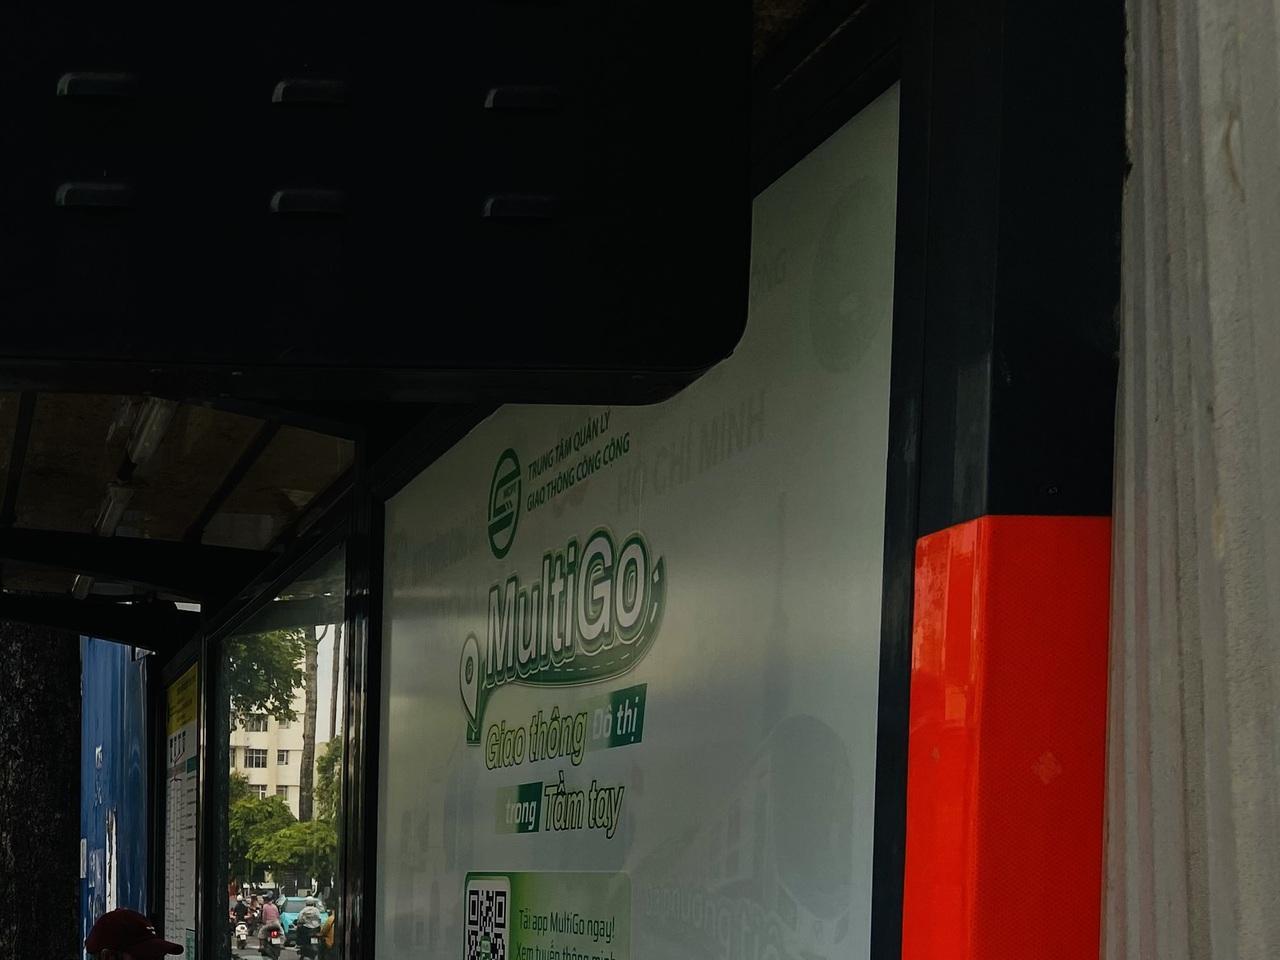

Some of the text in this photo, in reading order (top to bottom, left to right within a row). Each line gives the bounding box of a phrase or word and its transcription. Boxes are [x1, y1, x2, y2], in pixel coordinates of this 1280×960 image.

[526, 486, 545, 513] GIAO
[546, 467, 575, 501] THÔNG
[575, 450, 602, 482] CÔNG
[602, 432, 631, 470] CỘNG
[527, 448, 554, 480] TRUNG
[555, 437, 572, 464] TÂM
[573, 416, 599, 452] QUẢN
[486, 532, 647, 678] MultiGo
[485, 719, 525, 770] Giao
[529, 706, 589, 767] thông
[616, 697, 640, 743] thị
[504, 770, 625, 840] trong Tầm tay
[519, 908, 616, 944] Tải app MultiGo ngay!
